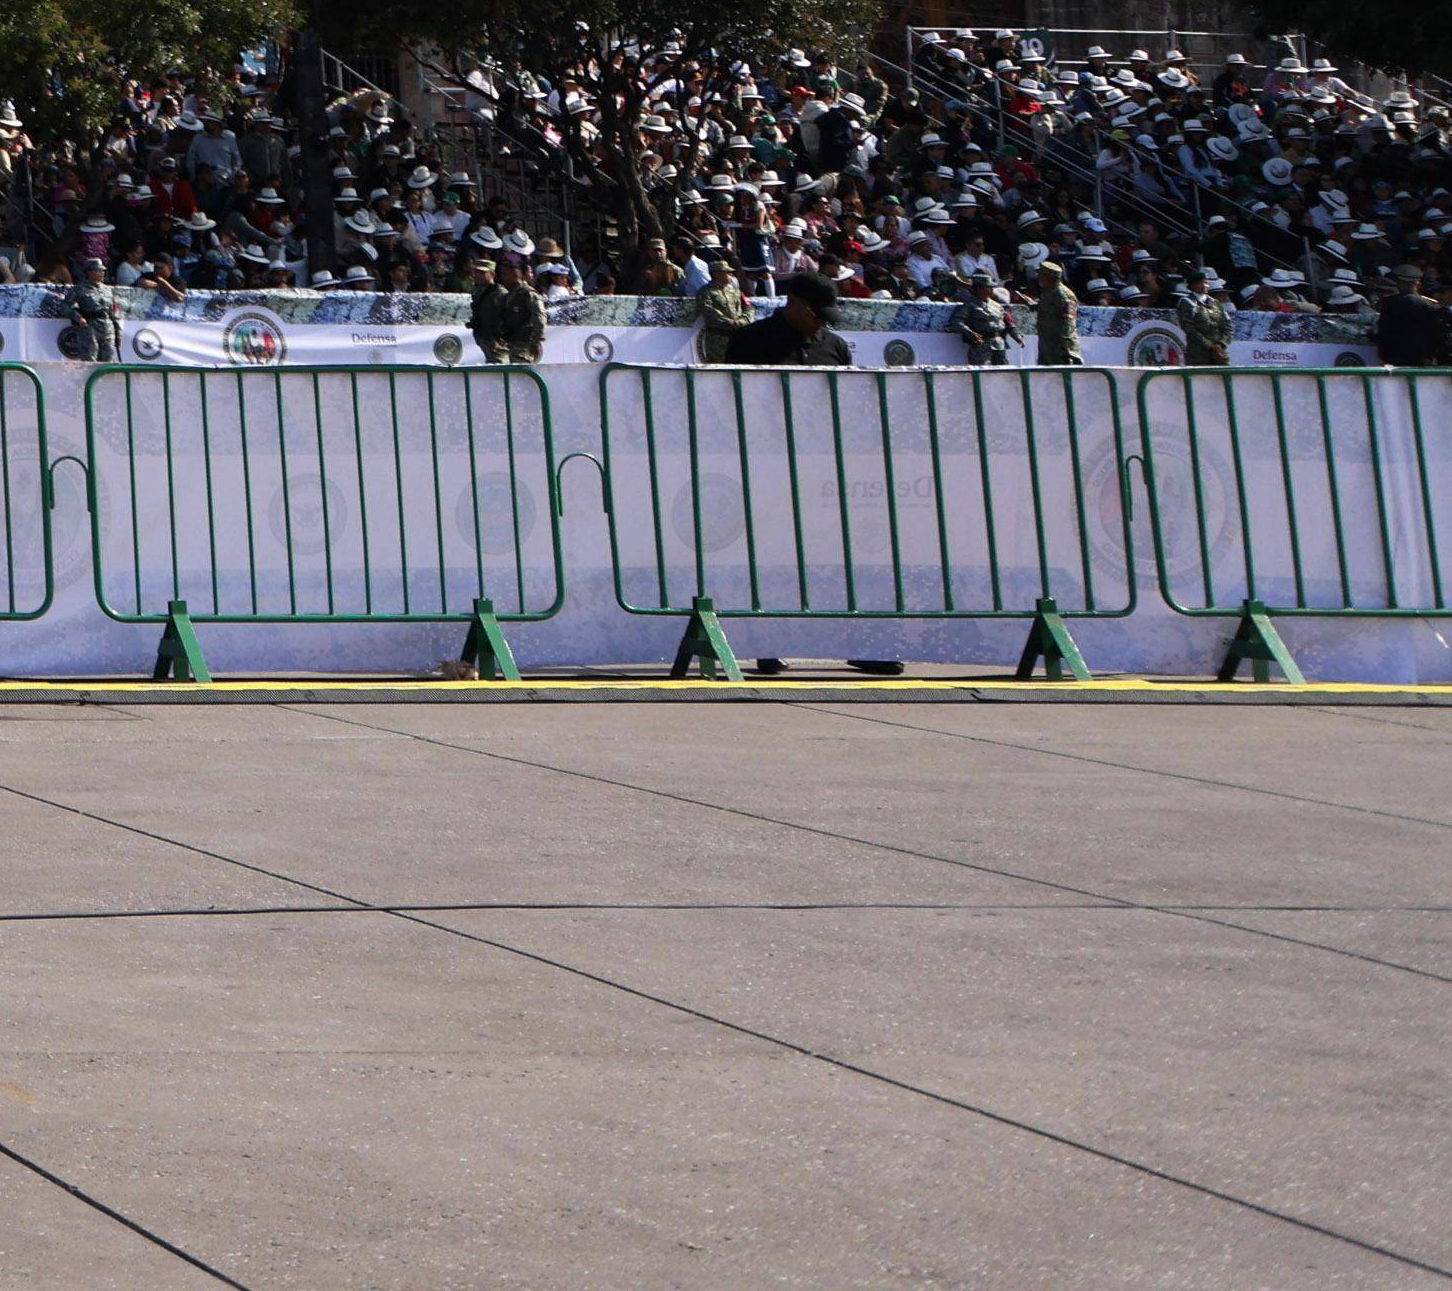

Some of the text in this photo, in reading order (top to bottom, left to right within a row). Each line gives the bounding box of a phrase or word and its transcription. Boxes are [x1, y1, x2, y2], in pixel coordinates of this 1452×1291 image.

[1019, 37, 1043, 56] 19
[350, 332, 397, 346] Defensa
[1252, 348, 1297, 362] Defensa
